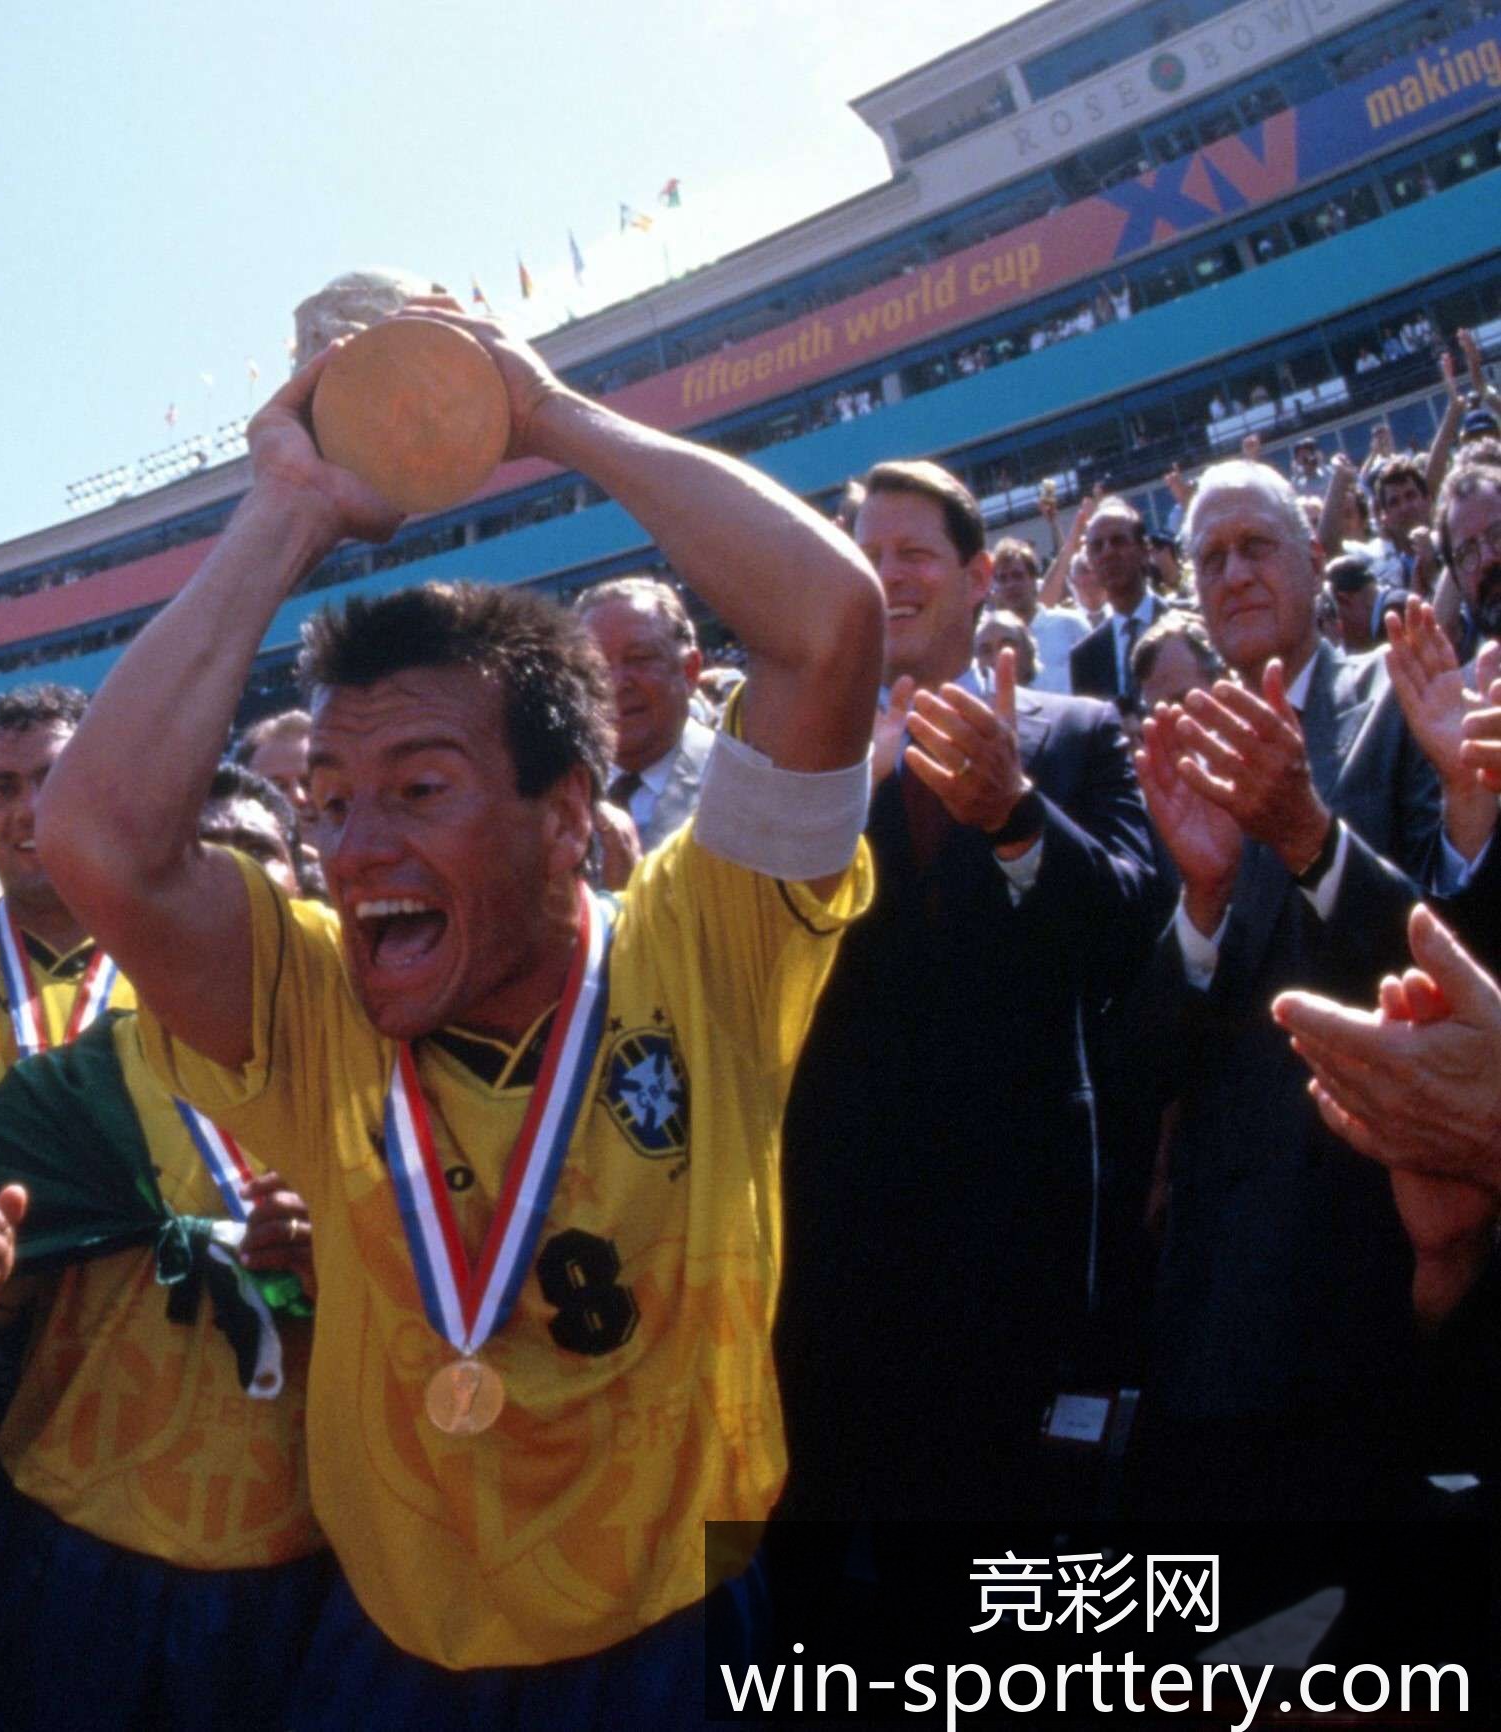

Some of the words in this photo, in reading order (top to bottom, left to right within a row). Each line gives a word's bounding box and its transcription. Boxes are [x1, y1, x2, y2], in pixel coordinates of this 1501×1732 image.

[1010, 79, 1142, 156] ROSE
[1194, 0, 1336, 71] BOWL
[1366, 37, 1501, 129] making
[1102, 107, 1298, 257] XV
[681, 318, 833, 408] fifteenth
[845, 266, 957, 347] world
[968, 242, 1043, 298] cup
[537, 1227, 640, 1357] 8
